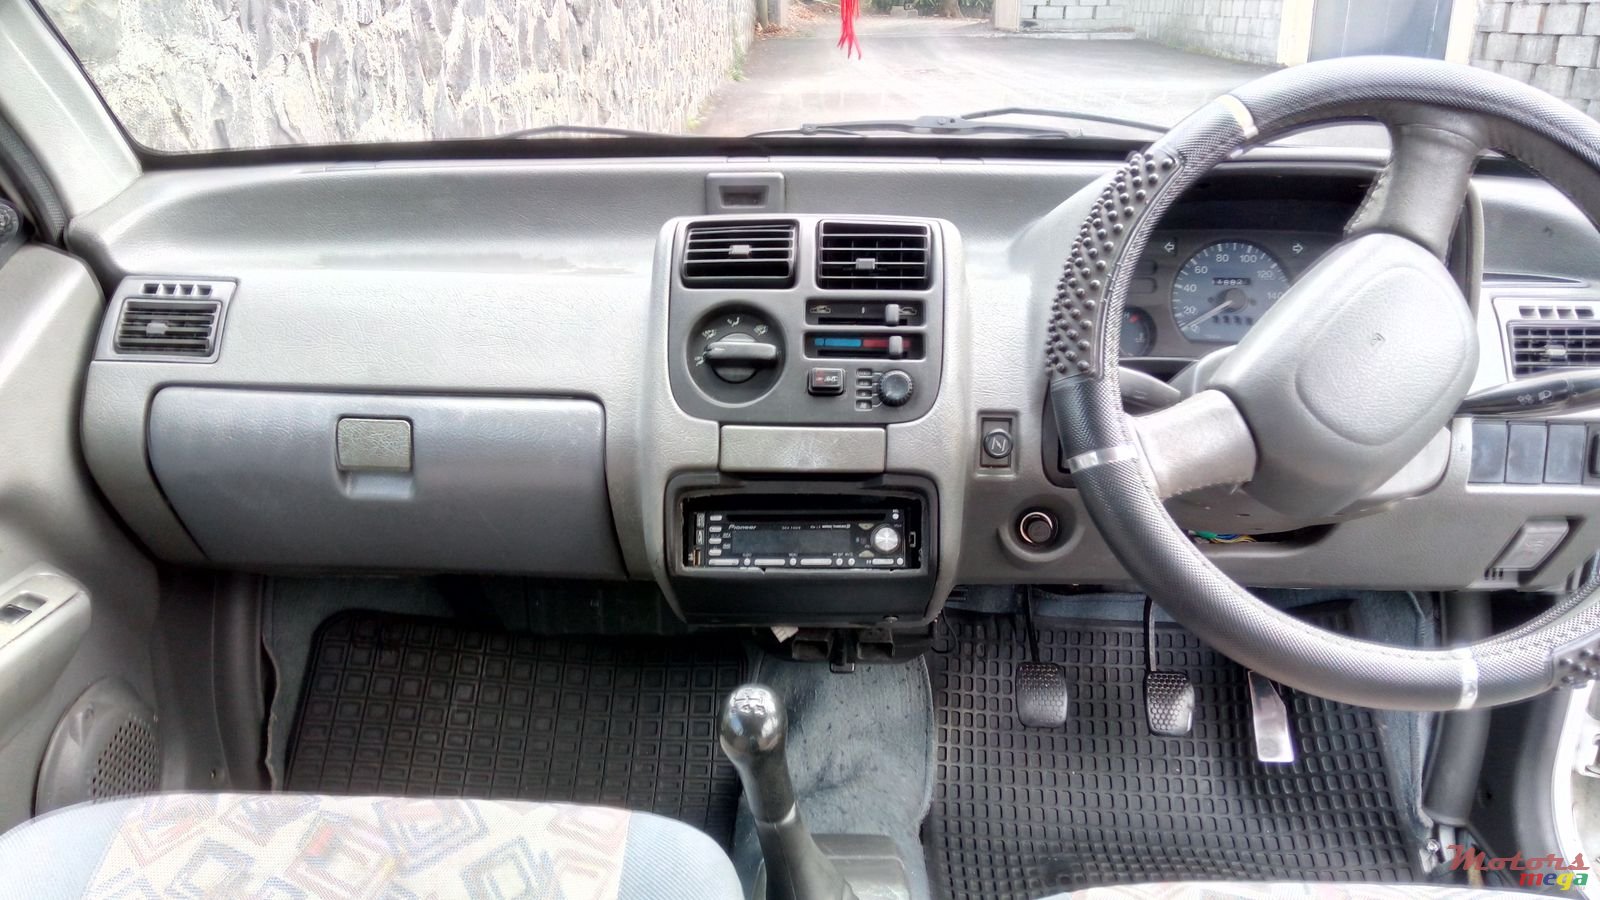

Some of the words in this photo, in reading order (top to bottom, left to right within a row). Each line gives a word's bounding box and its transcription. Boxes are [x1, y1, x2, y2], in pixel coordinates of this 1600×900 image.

[1216, 254, 1229, 263] 80
[1240, 254, 1257, 263] 100
[1194, 265, 1208, 274] 60
[1257, 271, 1273, 280] 120
[1183, 284, 1197, 292] 40
[1183, 306, 1196, 315] 20
